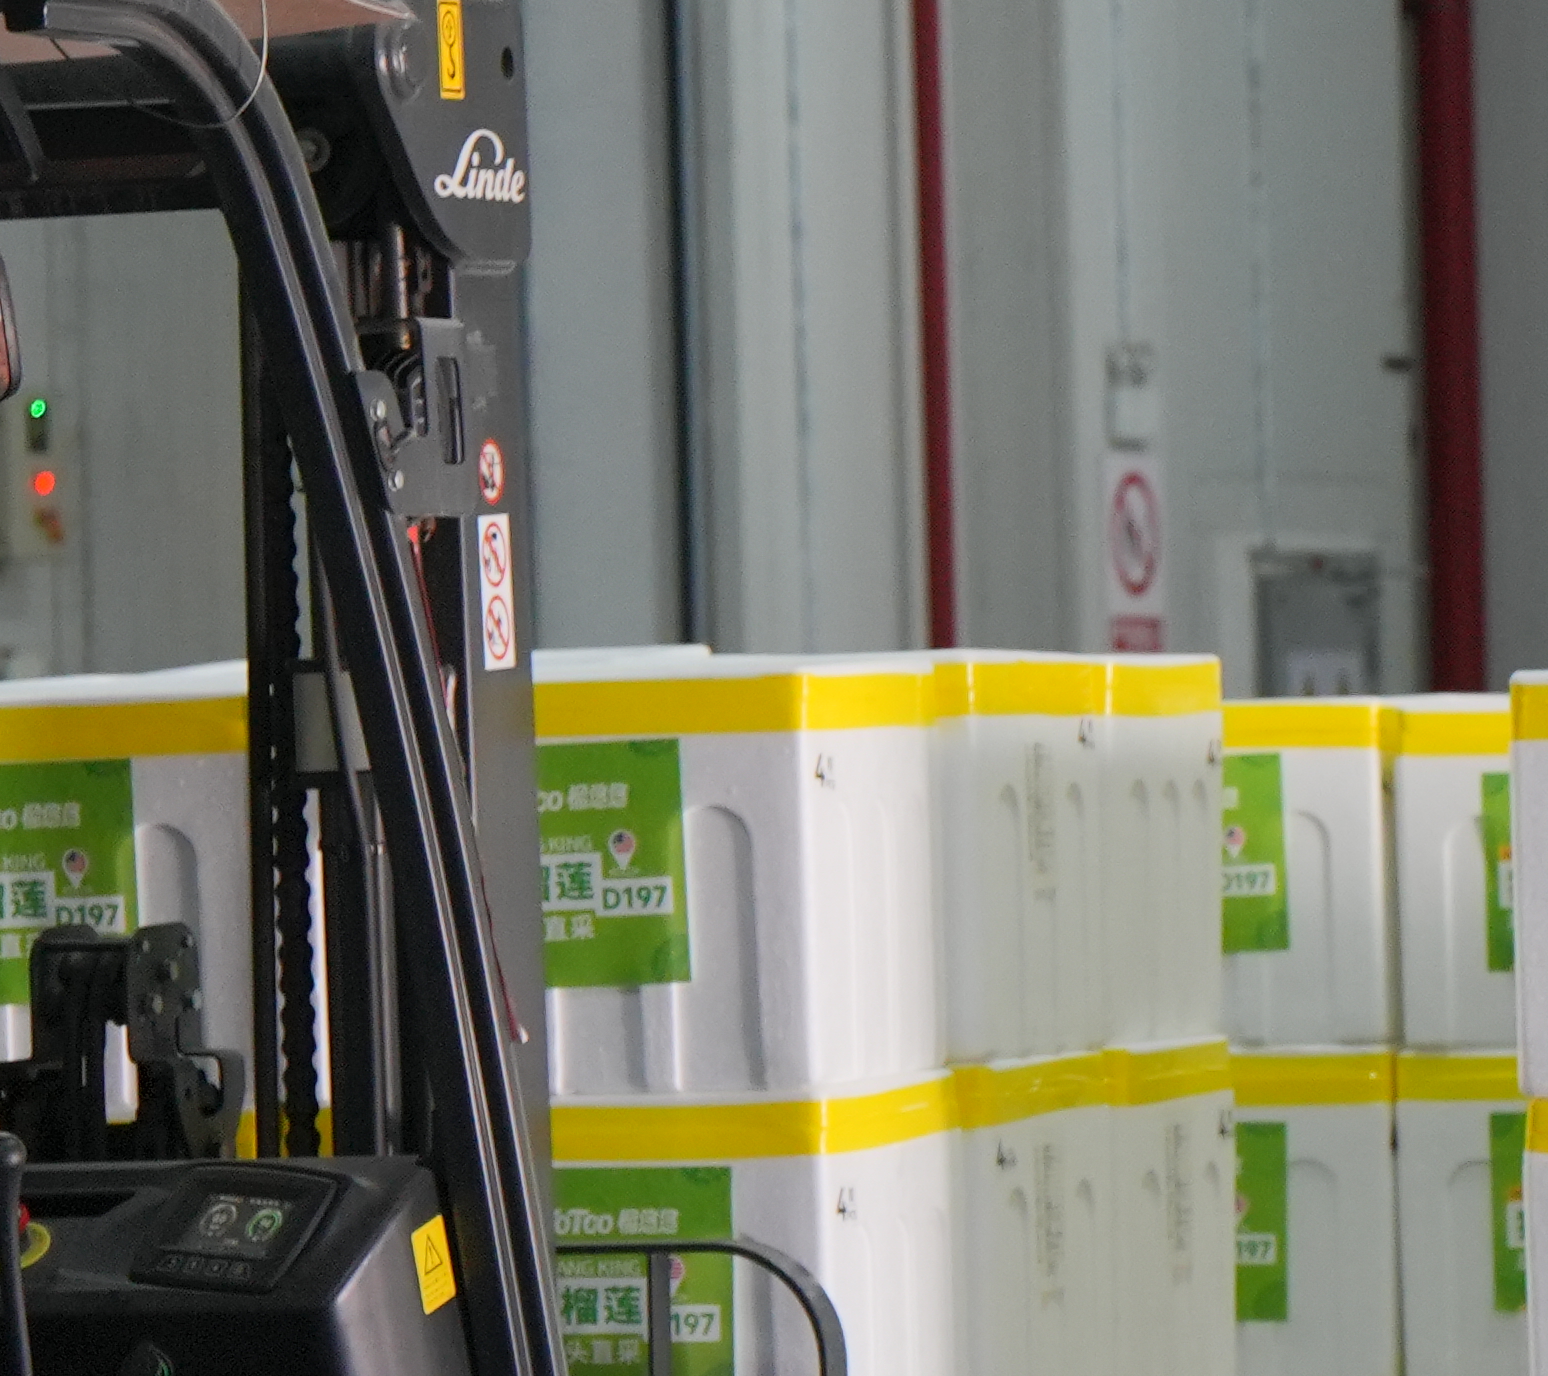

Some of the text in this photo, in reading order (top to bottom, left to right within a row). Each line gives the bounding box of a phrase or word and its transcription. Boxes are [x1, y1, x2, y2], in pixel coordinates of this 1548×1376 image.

[434, 128, 526, 204] Linde
[602, 884, 668, 911] D197
[55, 904, 119, 927] D197
[670, 1312, 716, 1337] 197
